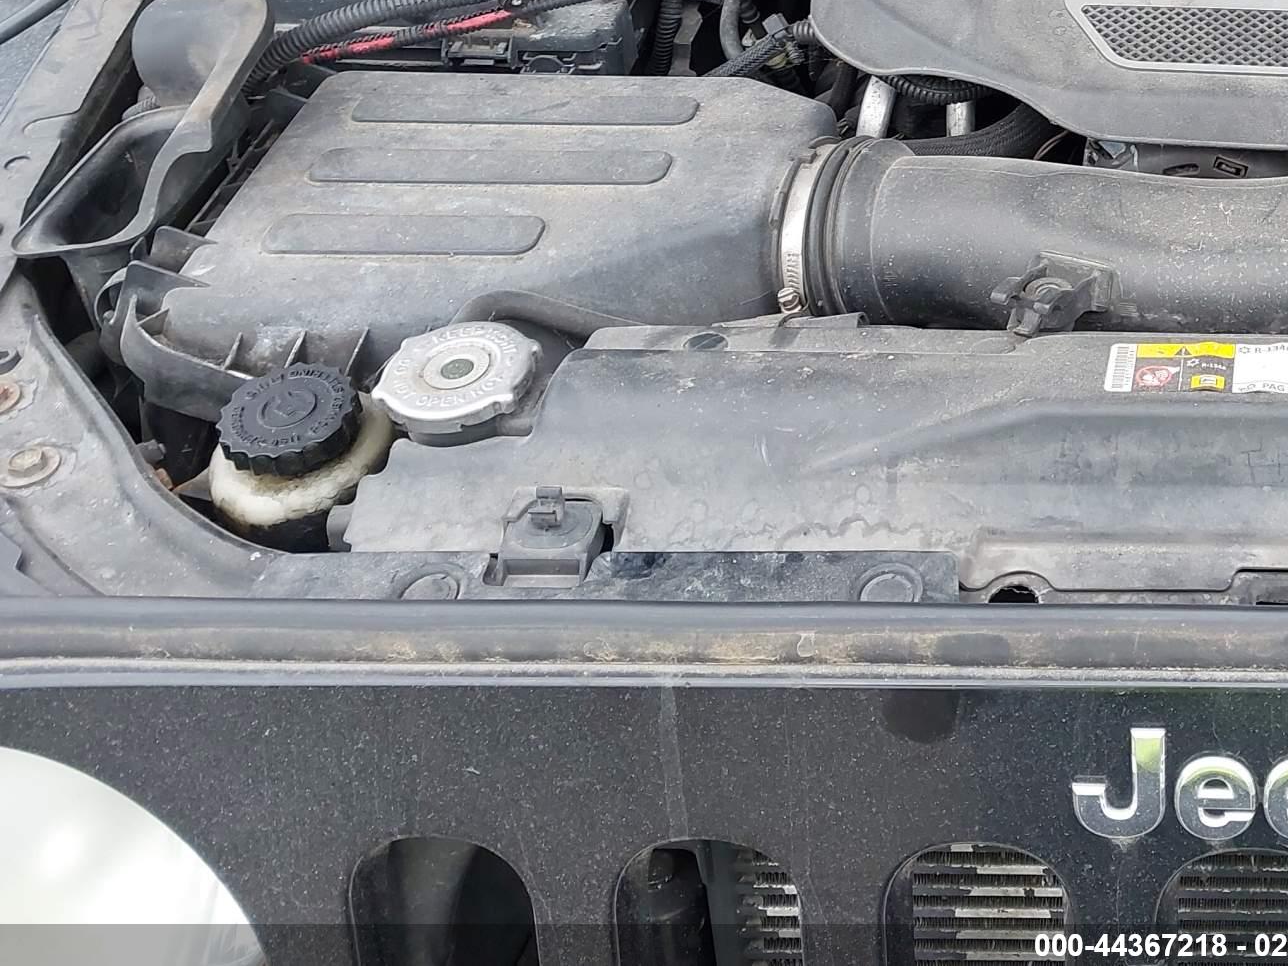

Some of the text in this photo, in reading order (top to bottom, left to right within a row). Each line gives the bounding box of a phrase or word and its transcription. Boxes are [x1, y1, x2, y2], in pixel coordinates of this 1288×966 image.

[433, 325, 486, 345] KEEP
[1262, 383, 1285, 392] PAG
[416, 394, 466, 407] OPEN
